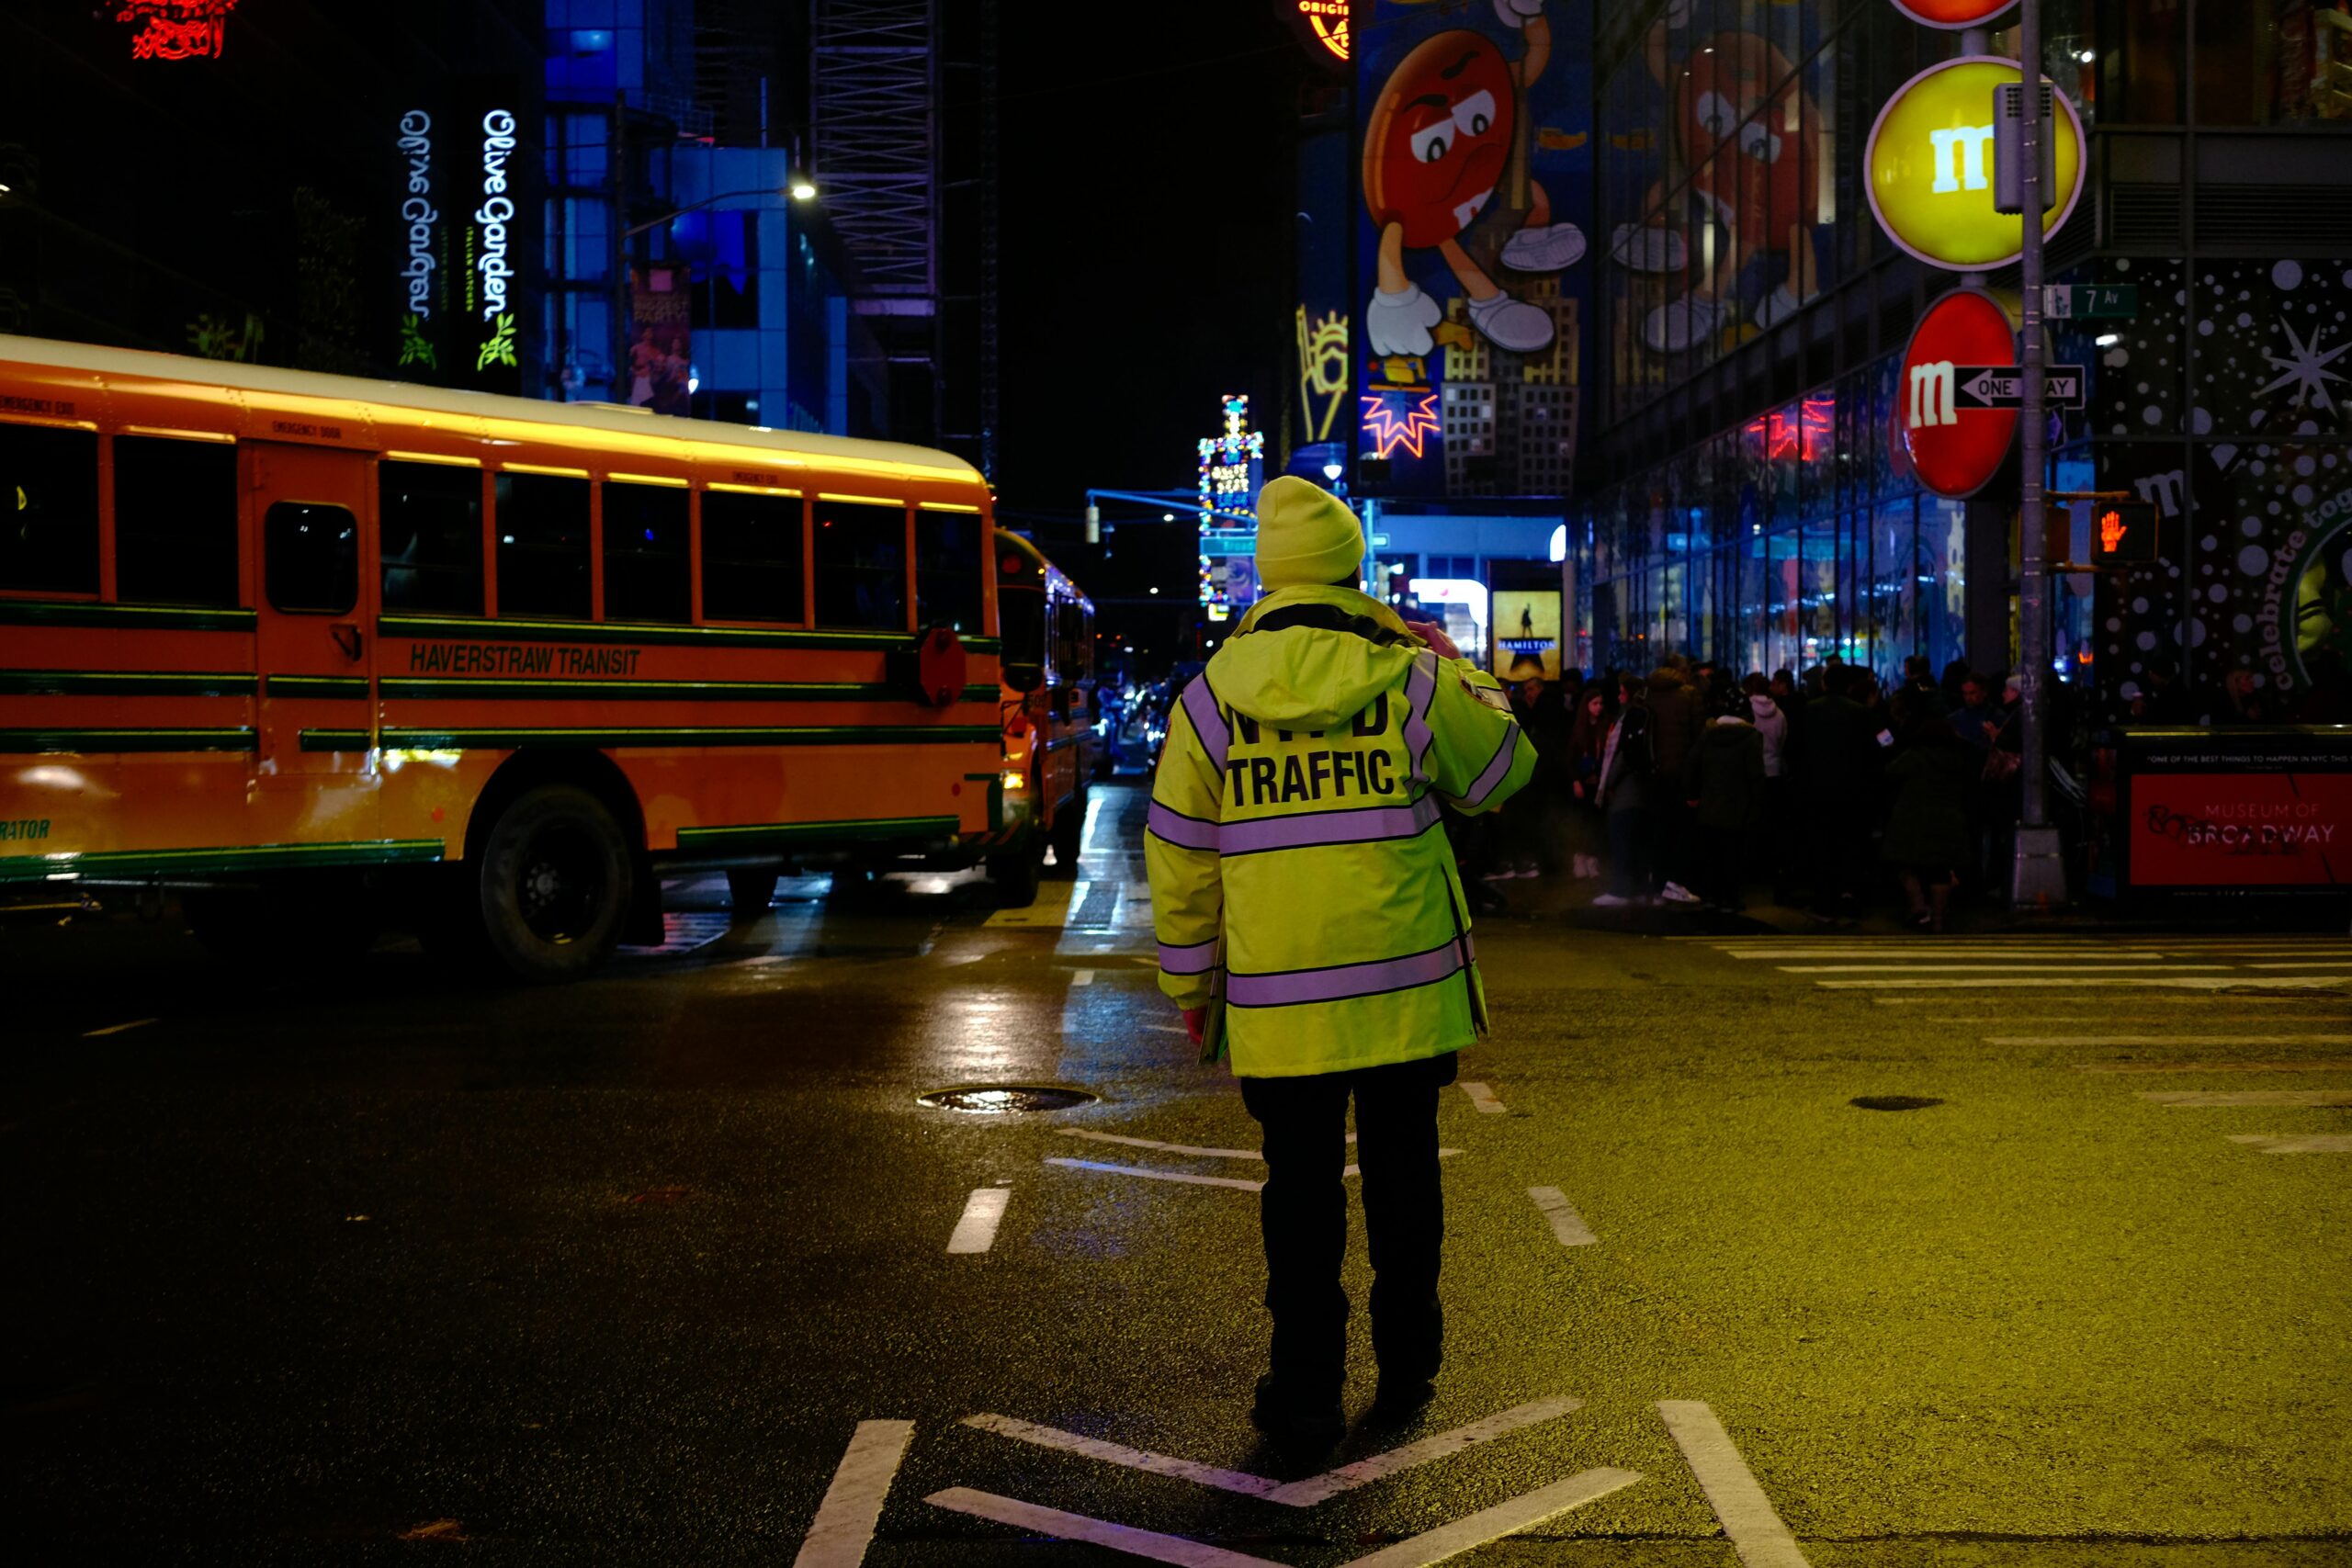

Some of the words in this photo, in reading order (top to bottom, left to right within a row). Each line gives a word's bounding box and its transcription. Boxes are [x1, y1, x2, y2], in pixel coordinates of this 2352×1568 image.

[482, 108, 516, 195] Olive
[474, 196, 515, 321] Garden
[2086, 289, 2098, 313] 7
[1909, 359, 1959, 429] m
[1978, 379, 2012, 396] ONE
[2044, 379, 2069, 396] AY
[410, 643, 555, 673] HAVERSTRAW
[557, 648, 640, 675] TRANSIT
[1498, 640, 1557, 650] HAMILTON
[1226, 691, 1388, 747] ND
[2183, 755, 2199, 763] THE
[2200, 755, 2219, 763] BEST
[2221, 755, 2251, 763] THINGS
[2253, 755, 2264, 763] TO
[2266, 755, 2298, 763] HAPPEN
[2301, 755, 2310, 763] IN
[2311, 755, 2328, 763] NYC
[2330, 755, 2348, 763] THIS
[1227, 749, 1394, 807] TRAFFIC
[2205, 802, 2289, 818] MUSEUM
[2295, 802, 2321, 818] OF
[2187, 824, 2335, 845] BROADWAY
